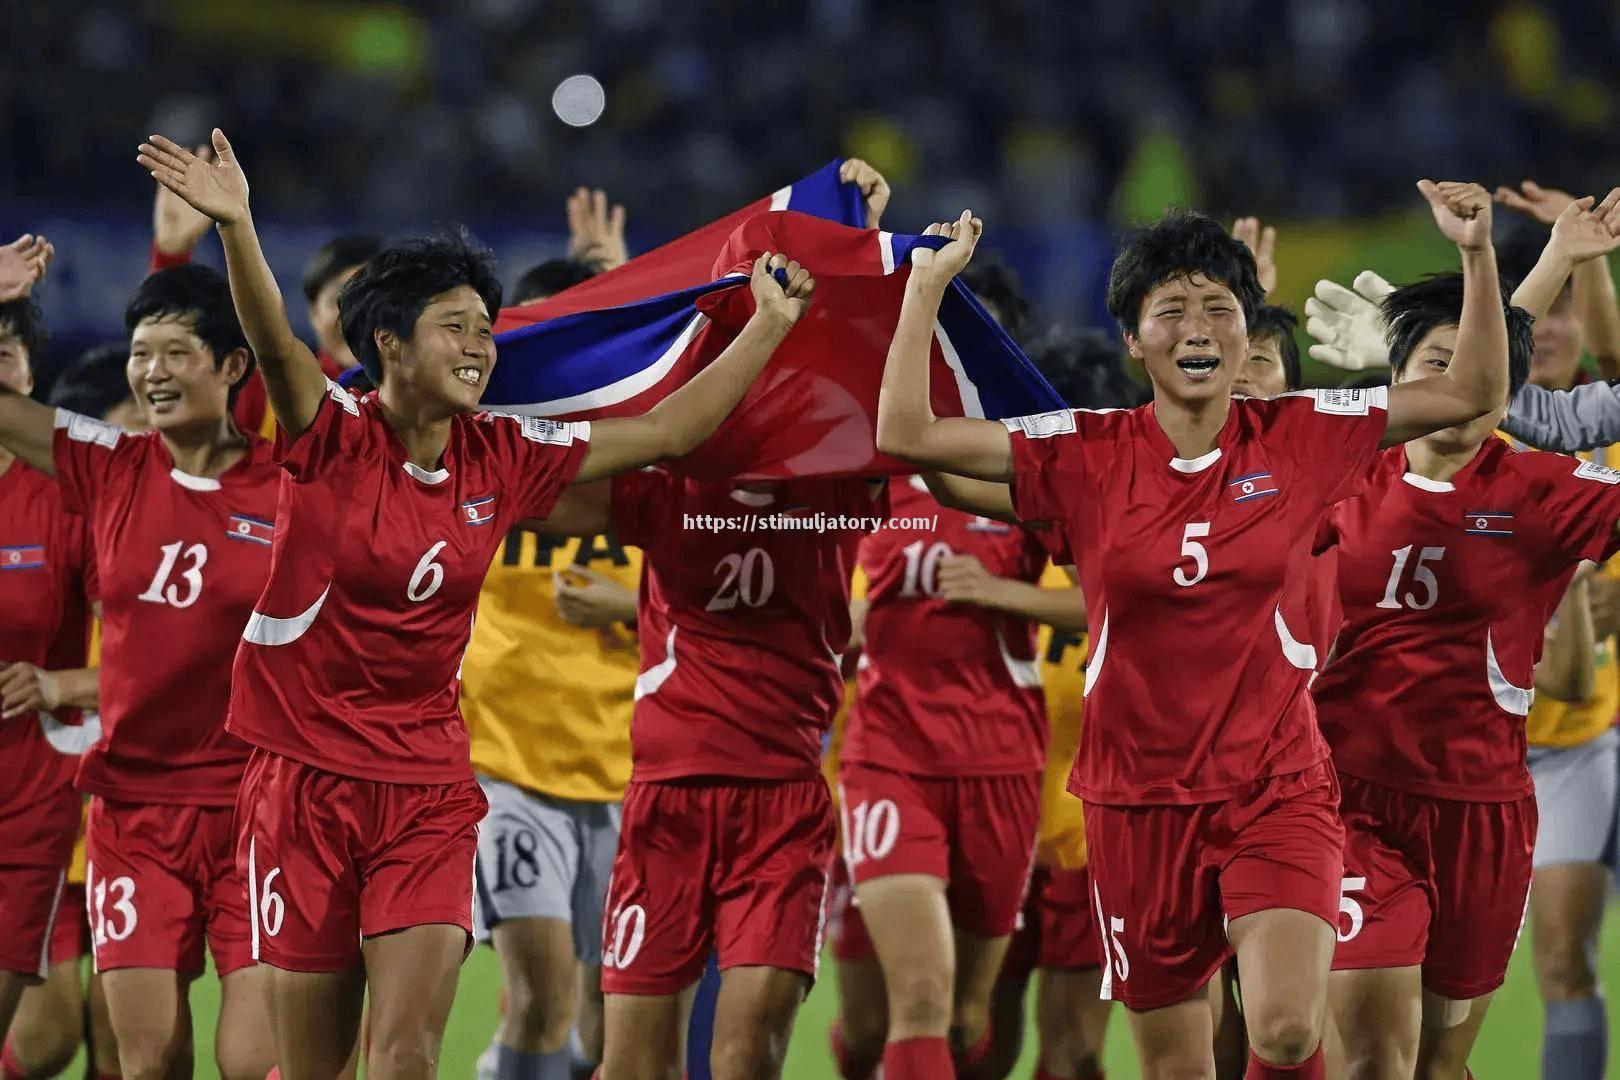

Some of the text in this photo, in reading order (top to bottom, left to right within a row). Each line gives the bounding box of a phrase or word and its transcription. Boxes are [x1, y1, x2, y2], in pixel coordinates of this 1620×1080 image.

[138, 540, 208, 608] 13
[407, 540, 447, 602] 6
[705, 547, 775, 611] 20
[1172, 521, 1211, 587] 5
[1375, 544, 1446, 610] 15
[493, 828, 541, 892] 18
[852, 799, 900, 864] 10
[94, 876, 138, 946] 13
[260, 866, 285, 937] 6
[1110, 915, 1130, 982] 5
